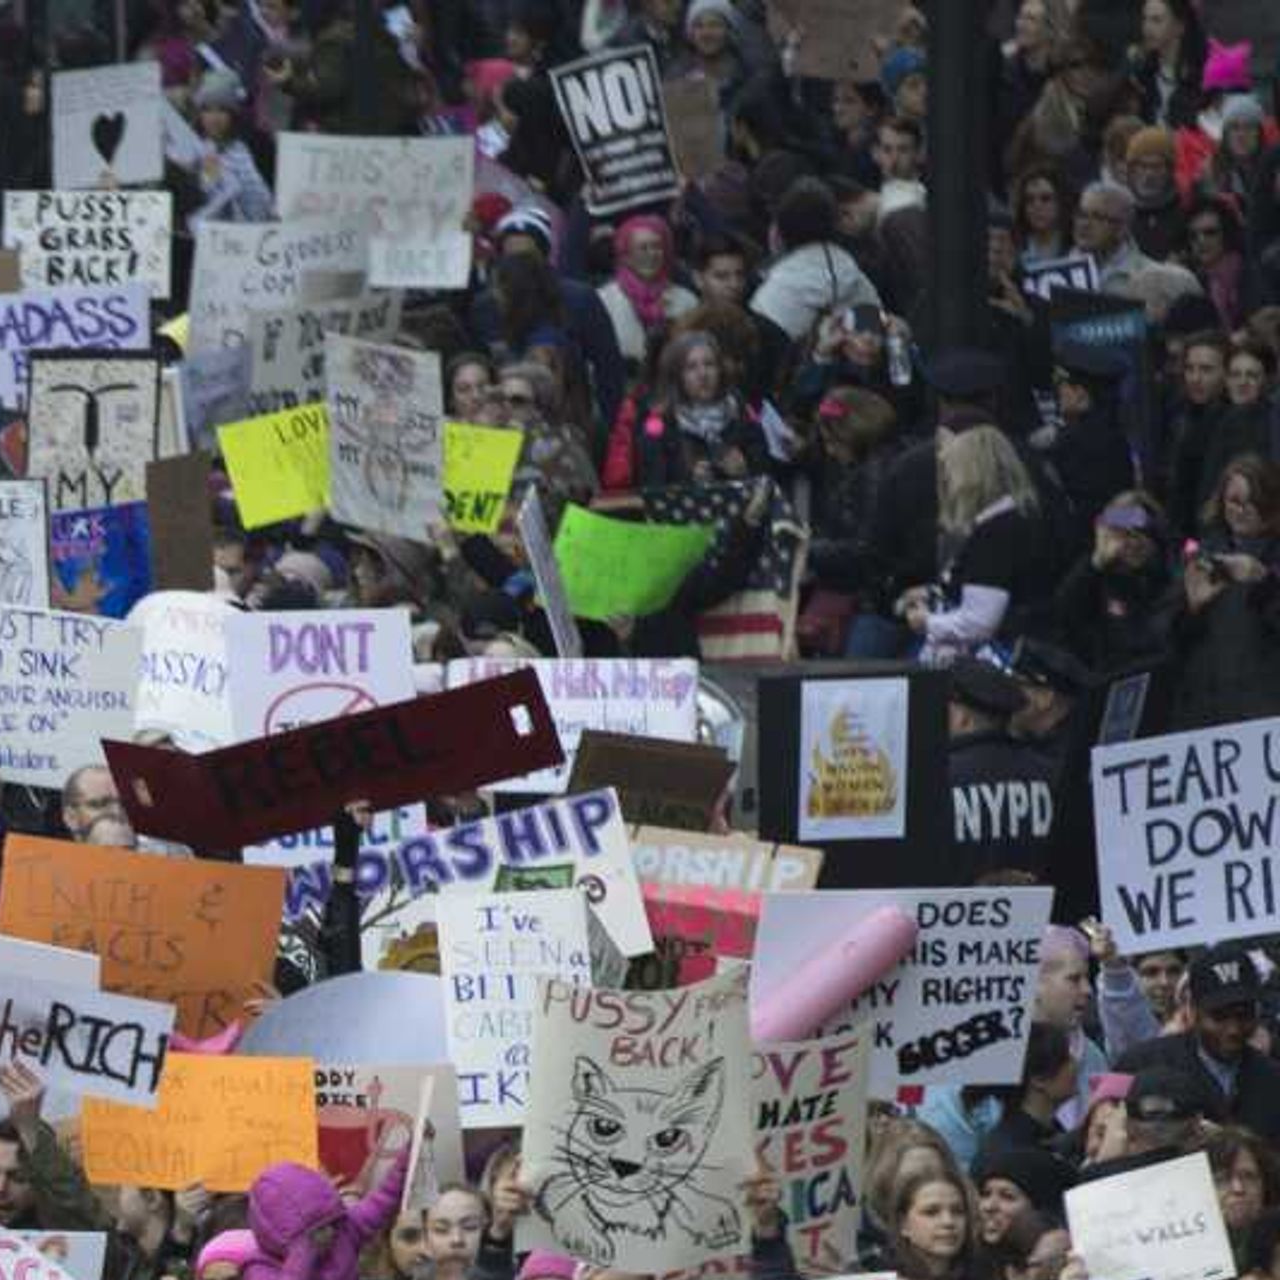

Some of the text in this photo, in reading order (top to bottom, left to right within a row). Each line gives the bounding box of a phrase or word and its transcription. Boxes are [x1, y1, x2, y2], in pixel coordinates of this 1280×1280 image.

[564, 57, 660, 146] NO!
[35, 192, 132, 223] PUSSY
[40, 225, 136, 252] GRABS
[46, 250, 138, 289] BACK!
[58, 460, 125, 510] MY
[17, 645, 81, 681] SINK
[1101, 739, 1241, 816] TEAR
[953, 781, 1053, 842] NYPD
[1145, 797, 1280, 867] DOW
[283, 792, 616, 917] WORSHIP
[478, 905, 540, 935] I've
[915, 898, 1013, 931] DOES
[1117, 870, 1196, 935] WE
[958, 938, 1041, 966] MAKE
[542, 978, 691, 1034] PUSSY
[921, 975, 1026, 1007] RIGHTS
[757, 1093, 838, 1130] HATE
[1135, 1214, 1207, 1246] WALLS
